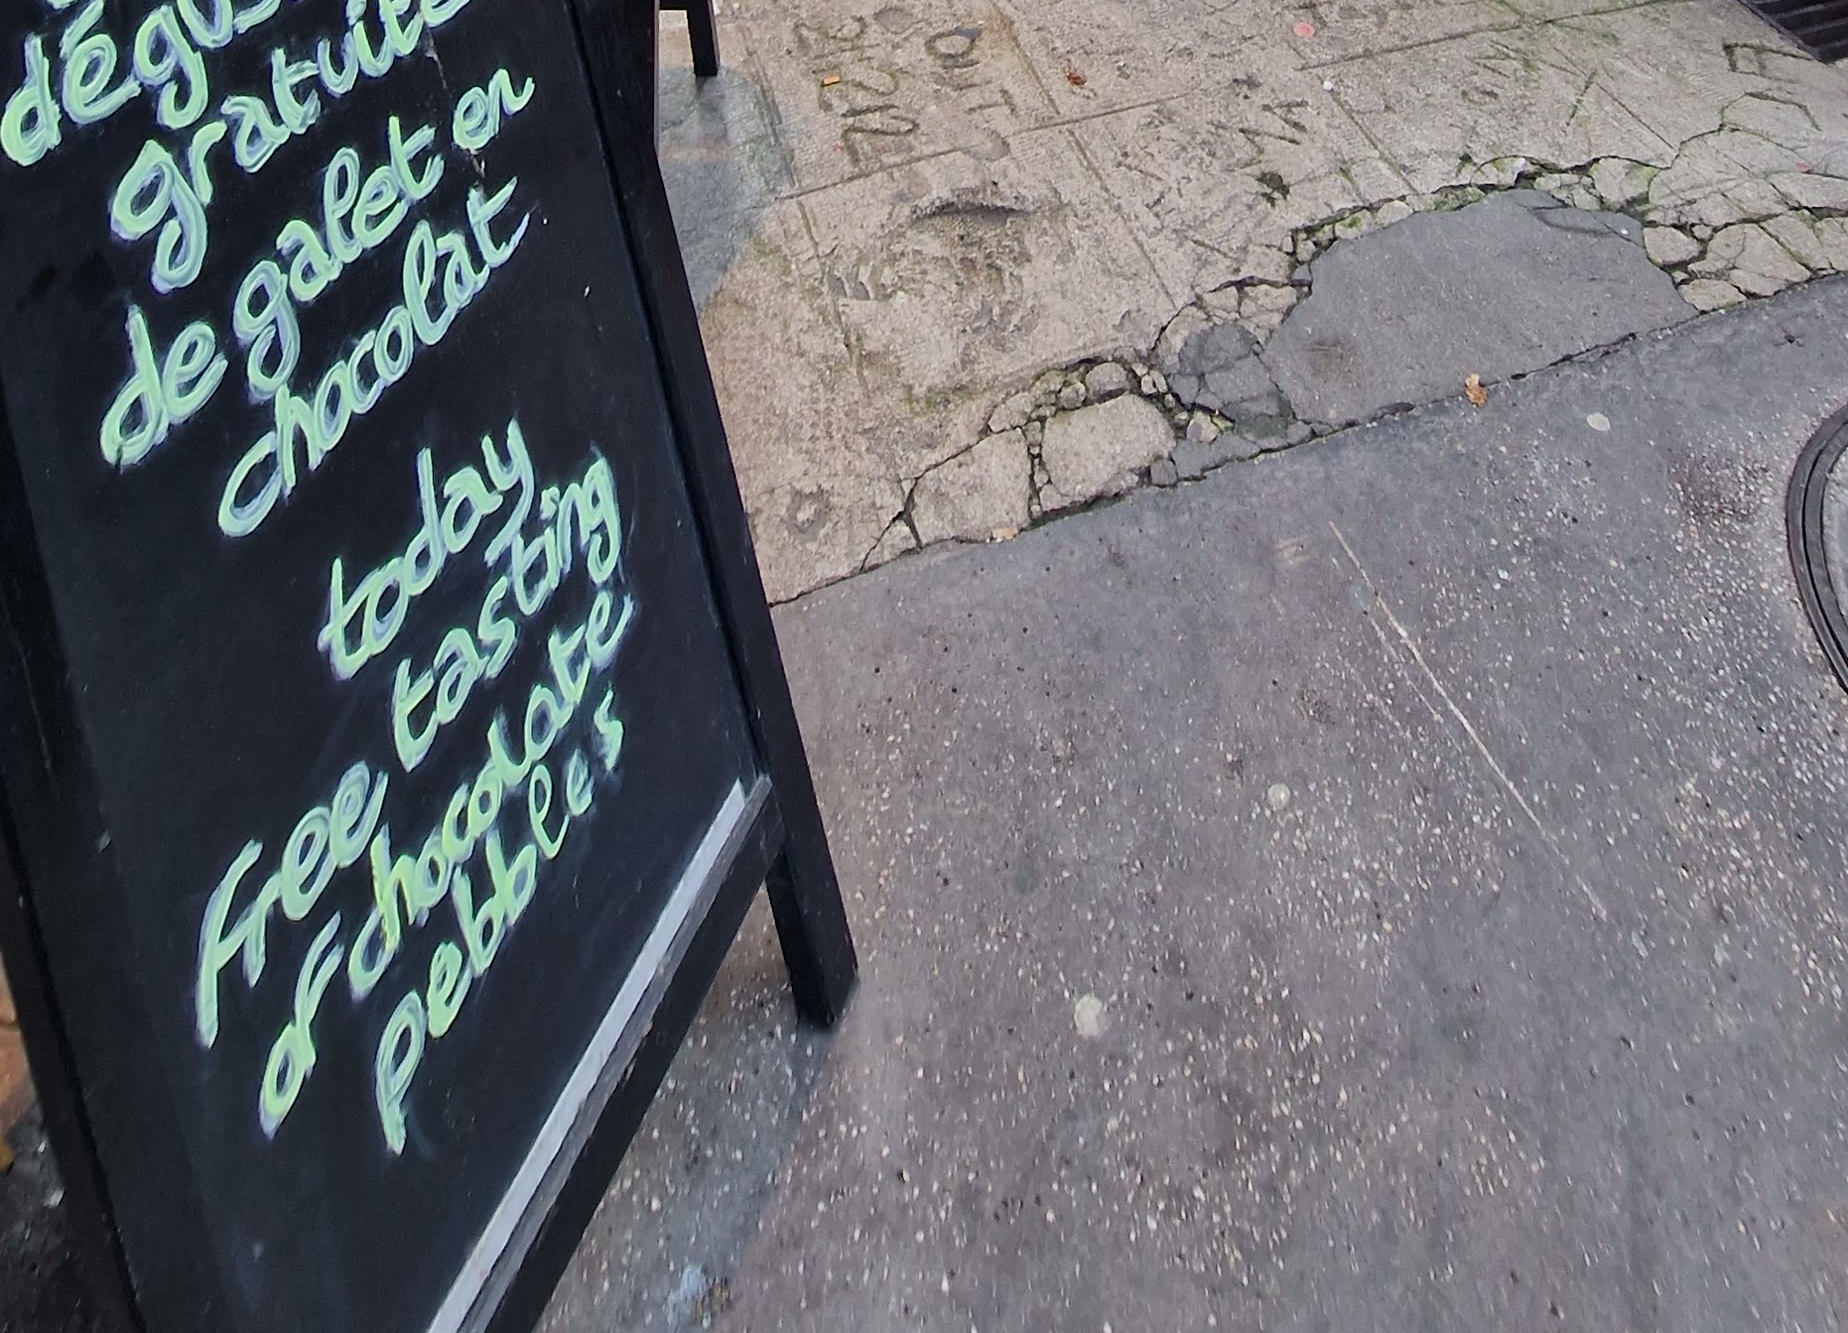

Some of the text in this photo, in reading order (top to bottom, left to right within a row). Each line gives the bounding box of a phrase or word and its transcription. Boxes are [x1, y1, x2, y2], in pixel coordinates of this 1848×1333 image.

[98, 67, 535, 467] de galet en
[218, 177, 531, 535] chocolat
[318, 417, 536, 681] today
[392, 444, 623, 771] tasting
[258, 590, 635, 1138] of chocolate
[373, 689, 625, 1155] pebbles
